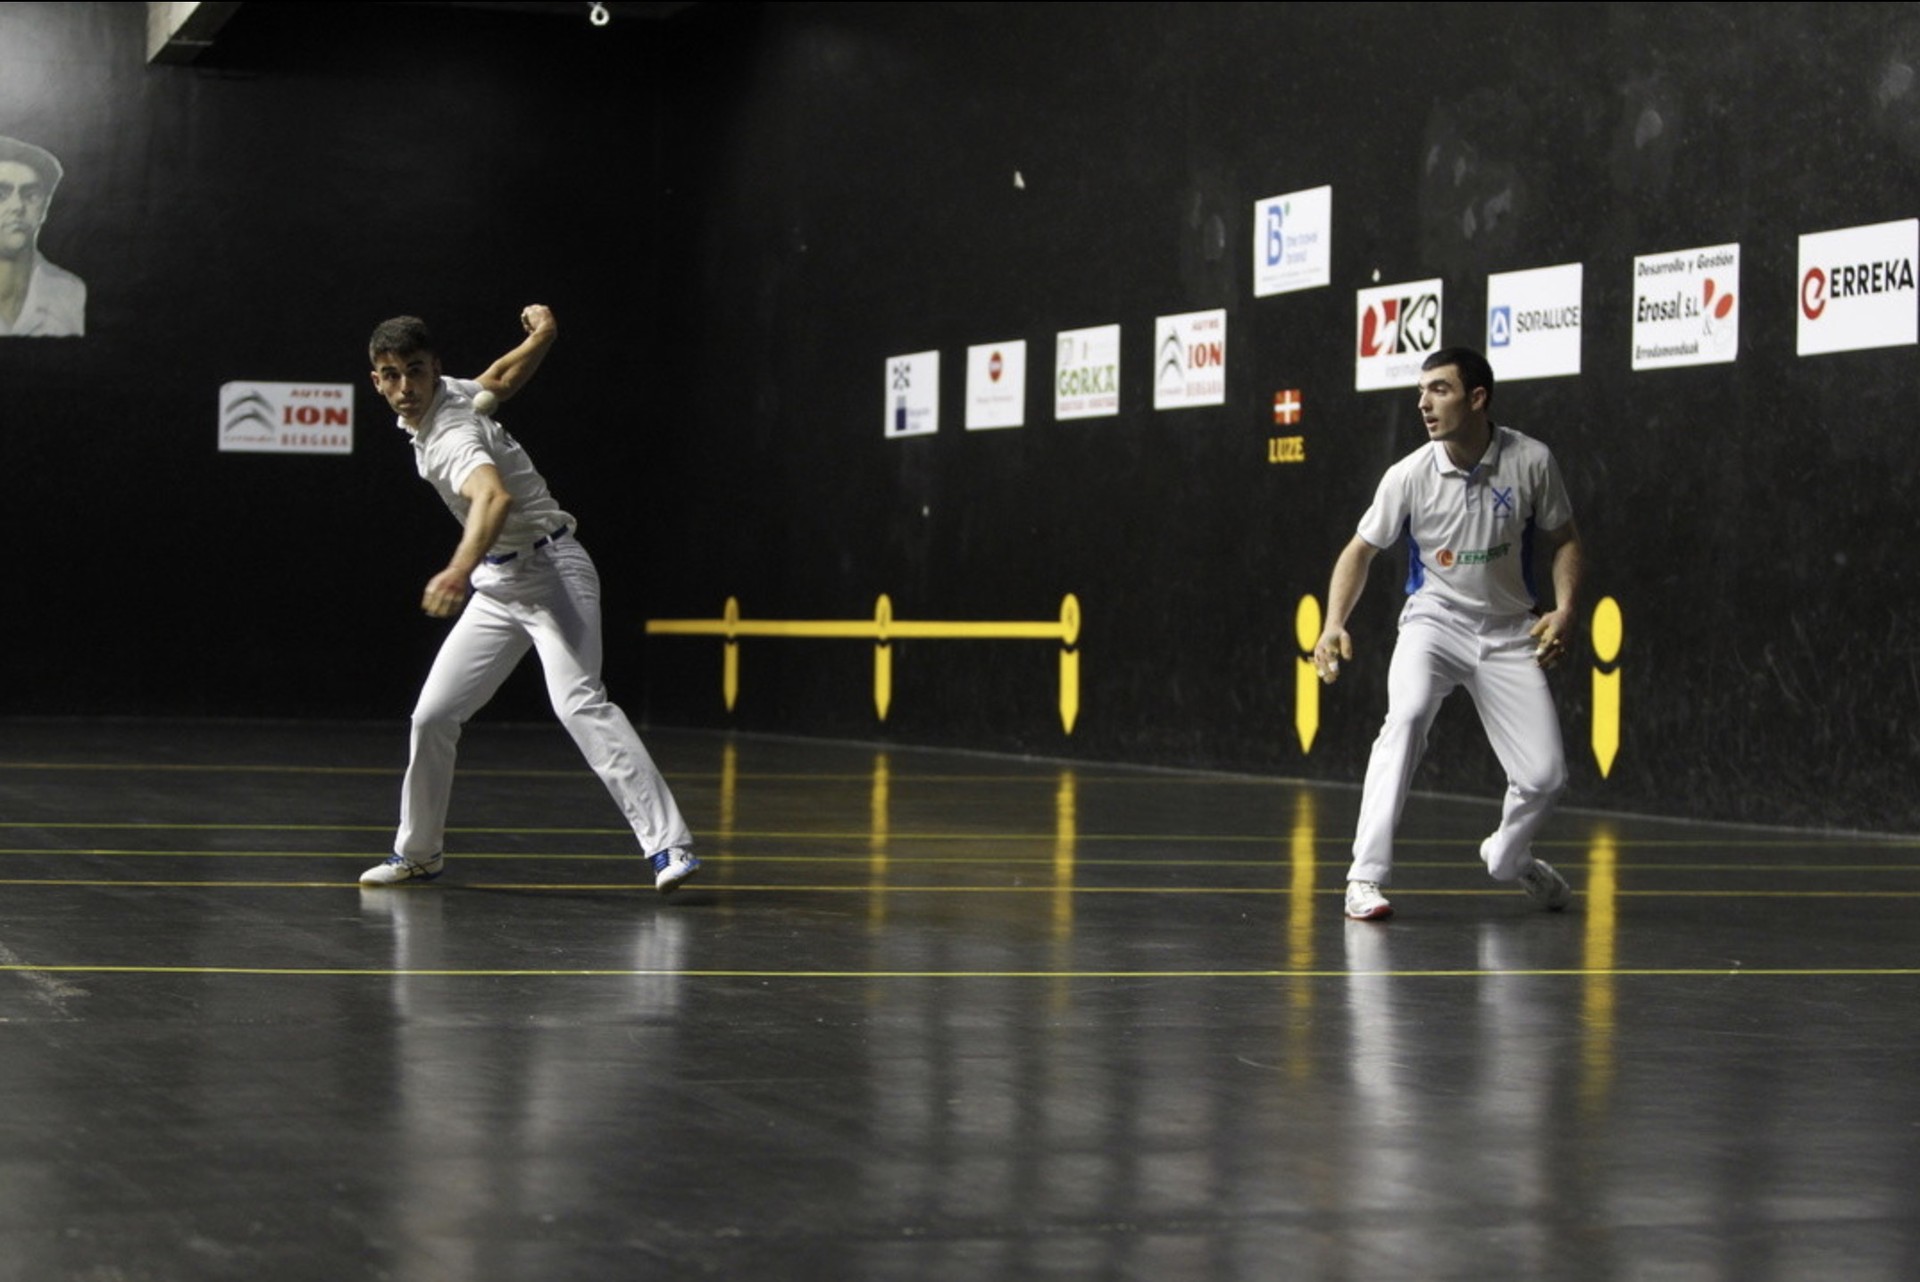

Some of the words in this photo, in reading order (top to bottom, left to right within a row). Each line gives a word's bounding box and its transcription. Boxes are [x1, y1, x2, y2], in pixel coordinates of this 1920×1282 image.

[1638, 258, 1685, 277] Desarrollo
[1687, 260, 1693, 273] y
[1830, 258, 1915, 299] ERREKA
[1517, 305, 1580, 333] SORALUCE
[1638, 291, 1682, 323] Erosal
[1187, 340, 1223, 369] ION
[289, 388, 343, 399] AUTOS
[283, 405, 348, 426] ION
[280, 434, 348, 446] BERGARA
[1268, 435, 1305, 463] LUZE
